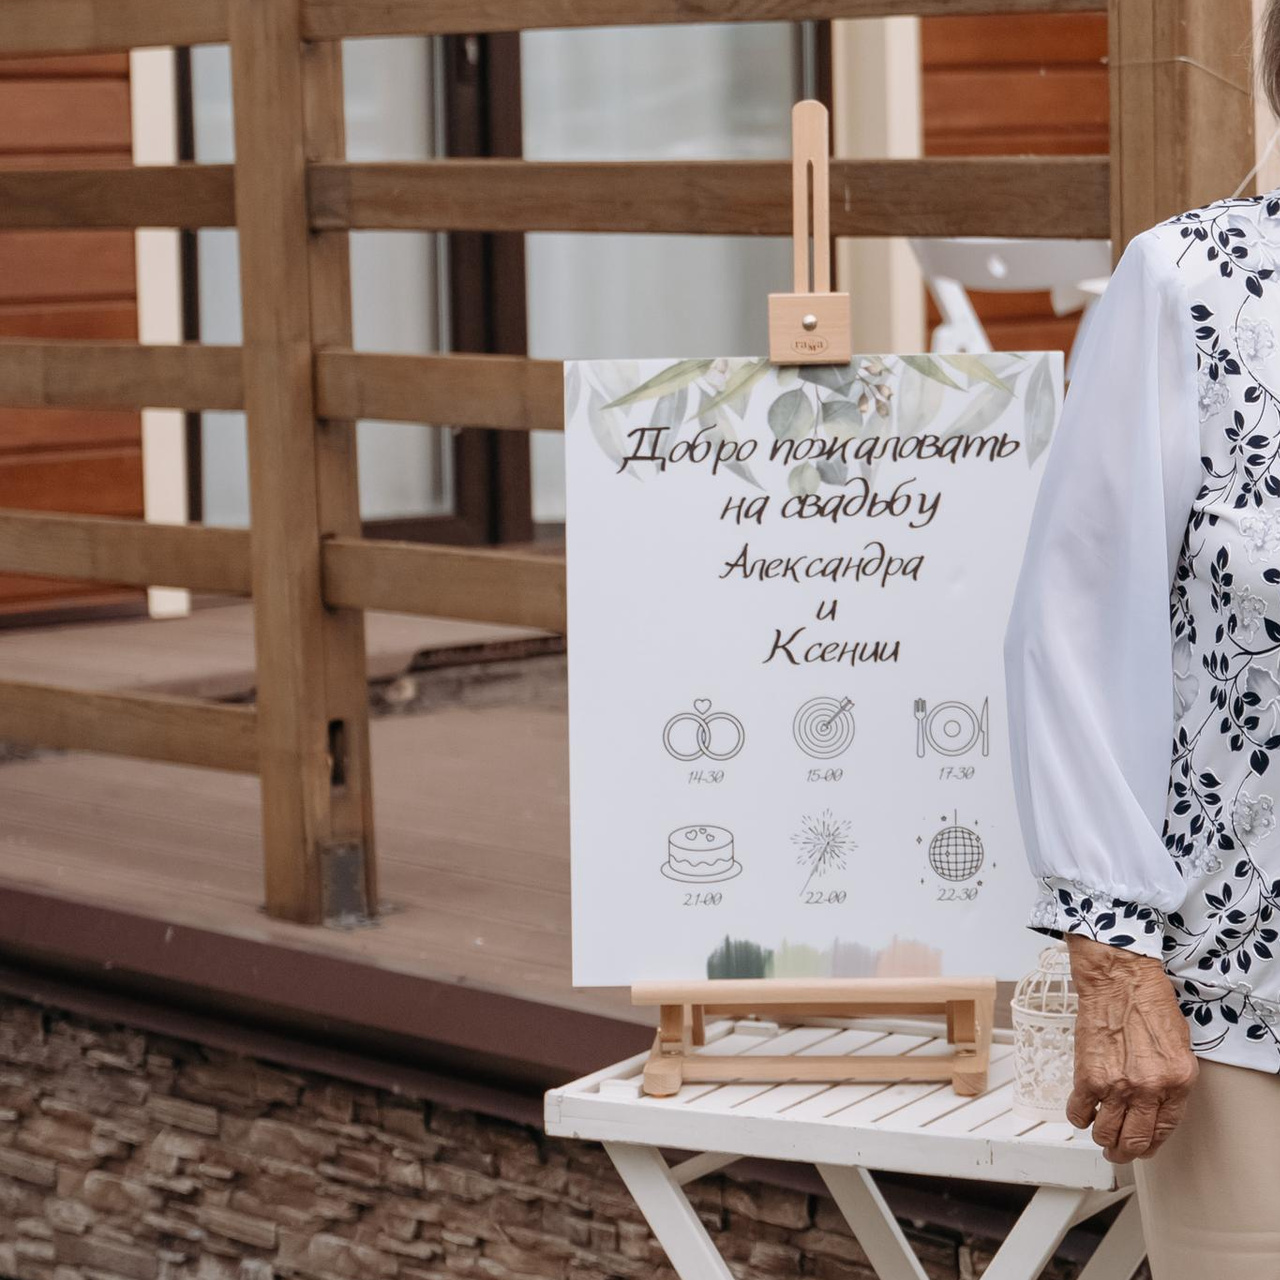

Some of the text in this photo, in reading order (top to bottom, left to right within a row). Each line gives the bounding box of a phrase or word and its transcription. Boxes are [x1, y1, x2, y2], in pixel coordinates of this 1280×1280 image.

[617, 424, 1020, 474] Добро пожаловать
[720, 477, 941, 528] на свадьбу
[719, 541, 924, 587] Александра
[815, 599, 838, 621] и
[762, 626, 900, 666] Ксении
[688, 770, 725, 784] 14-30
[806, 768, 843, 783] 15-00
[938, 766, 975, 781] 17-30
[682, 892, 723, 906] 21-00
[804, 890, 847, 904] 22-00
[936, 887, 979, 902] 22-30
